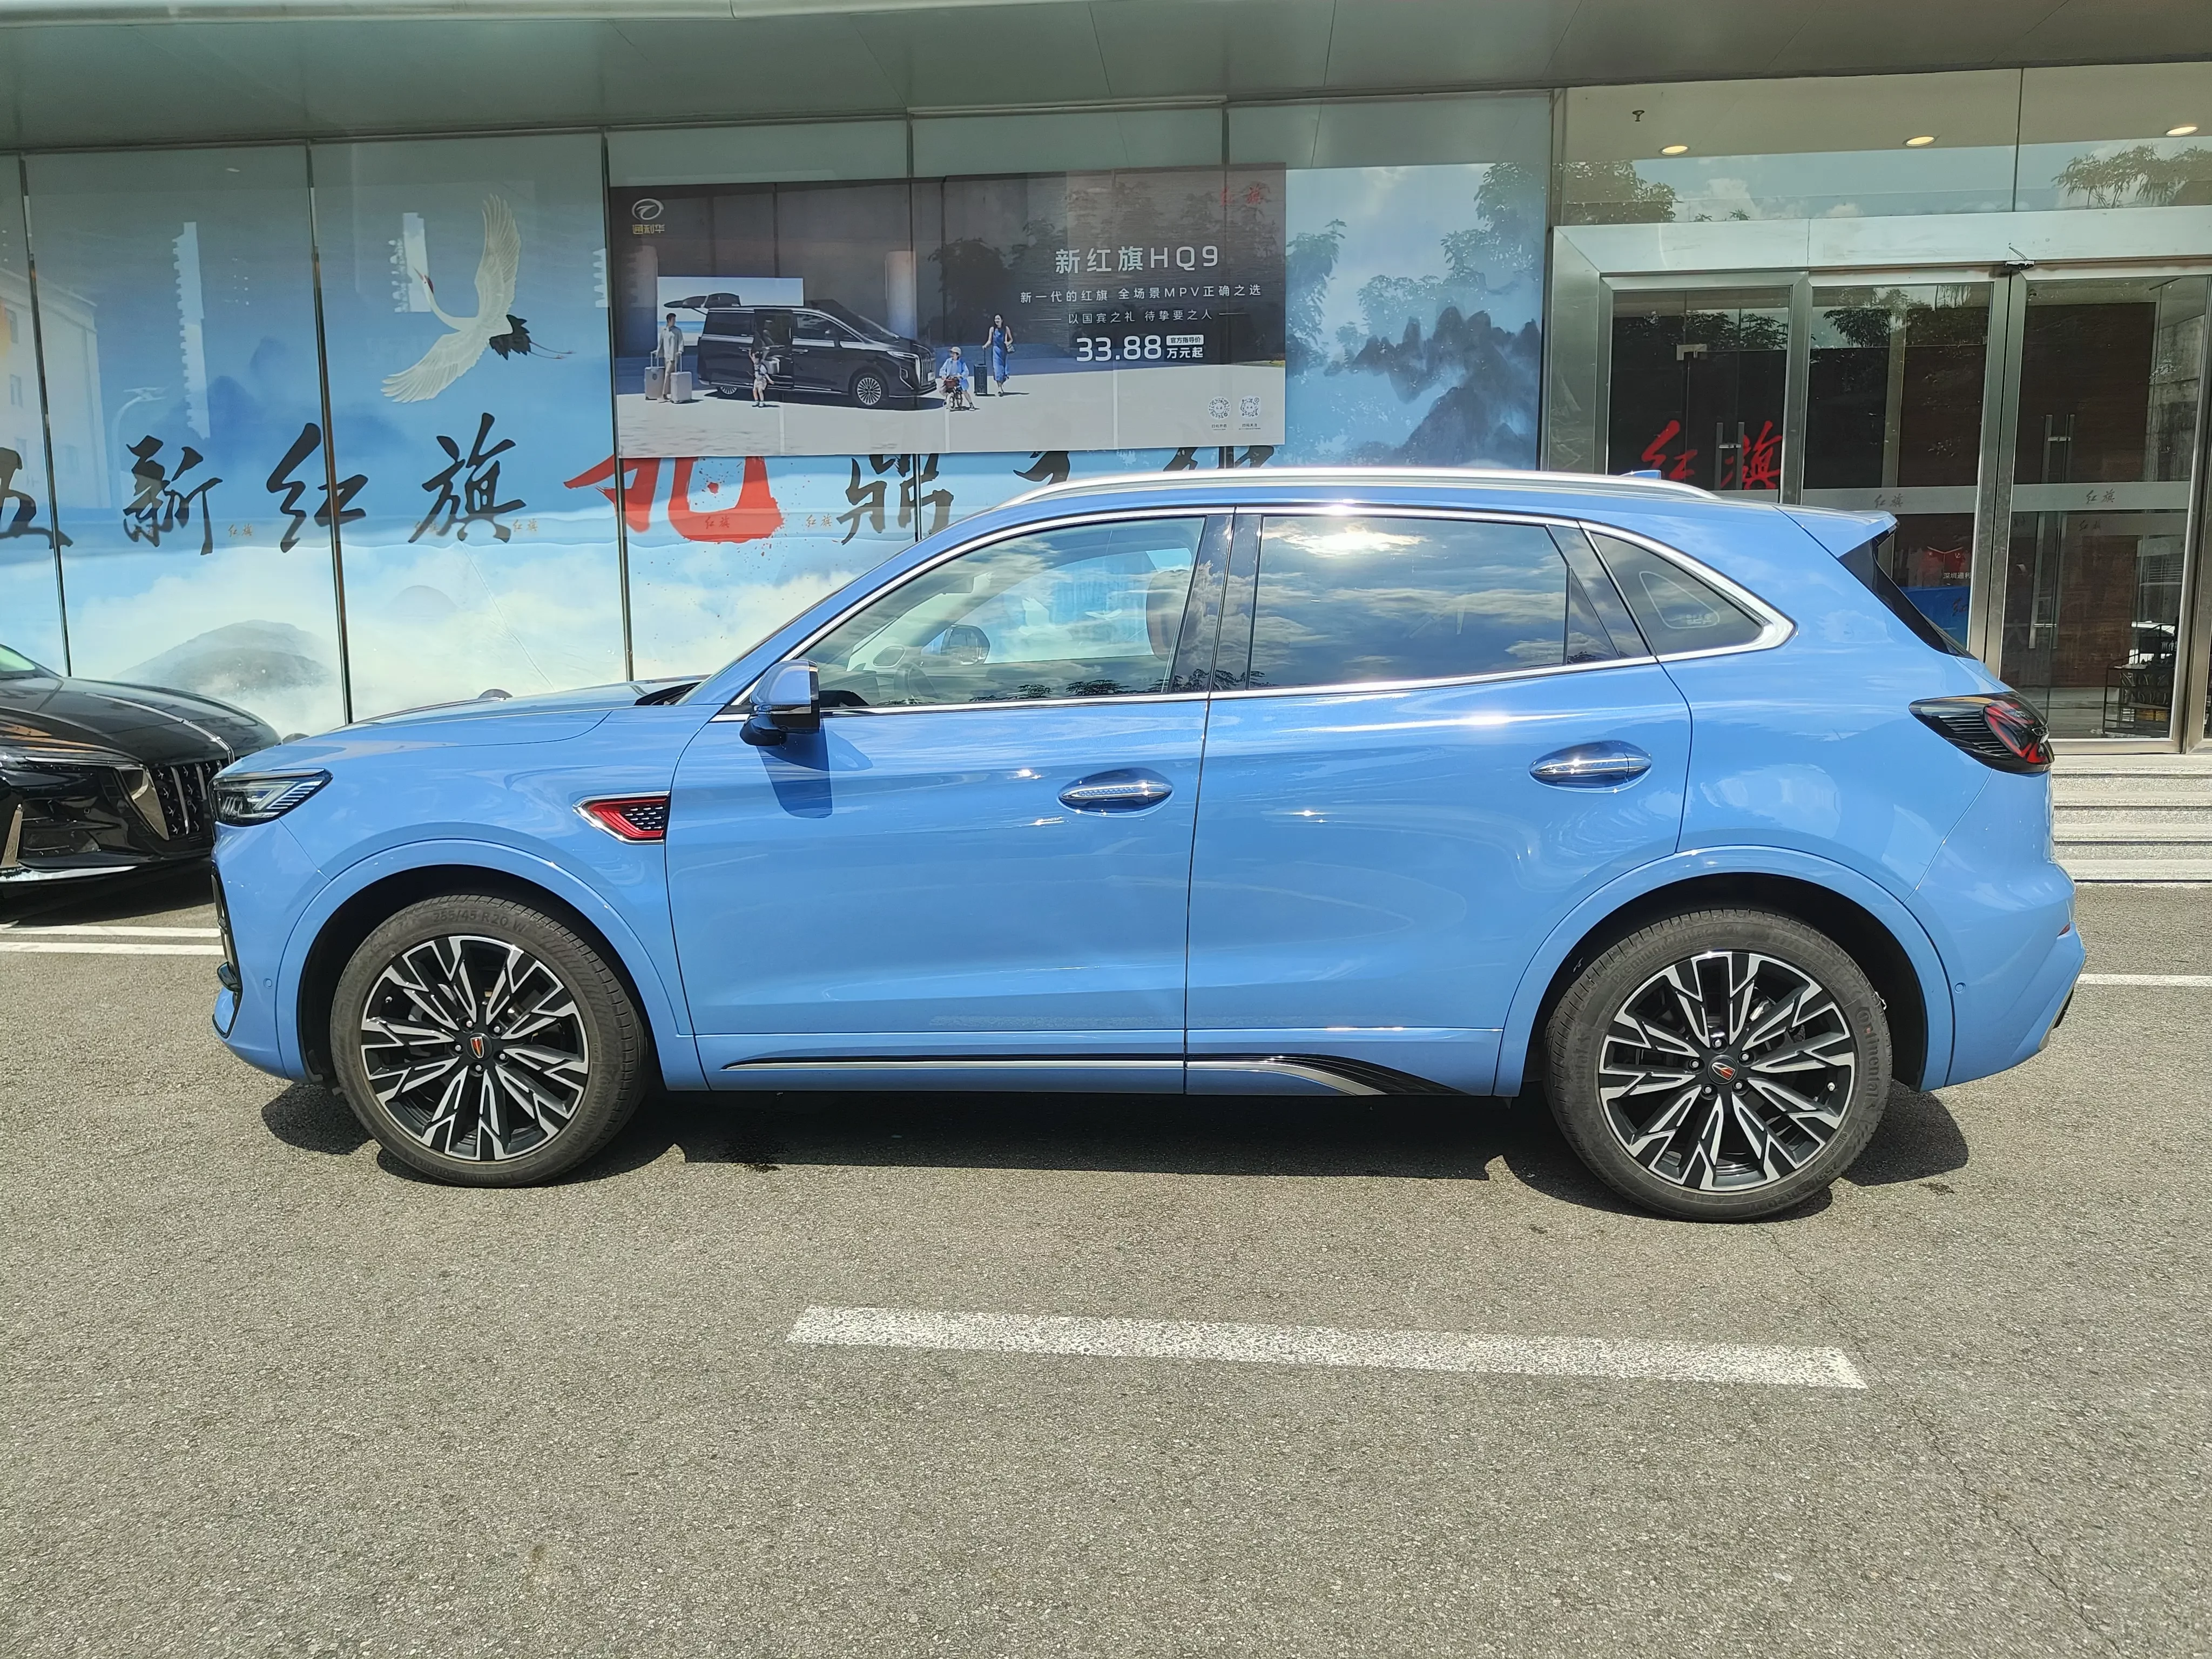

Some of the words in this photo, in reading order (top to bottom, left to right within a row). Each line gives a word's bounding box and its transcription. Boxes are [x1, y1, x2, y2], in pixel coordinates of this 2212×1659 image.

[1055, 246, 1218, 274] 新红旗HQ9
[1020, 289, 1108, 303] 新一代的红旗
[1118, 284, 1262, 300] 全场景MPV正确之选
[1068, 311, 1135, 323] 以国宾之礼
[1076, 335, 1162, 361] 33.88
[1166, 347, 1204, 359] 万元起
[1641, 420, 1783, 490] 红旗
[1874, 493, 1904, 508] 红旗
[2086, 488, 2115, 504] 红旗
[513, 518, 538, 532] 红旗
[705, 516, 730, 529] 红旗
[806, 514, 832, 527] 红旗
[228, 523, 253, 537] 红旗
